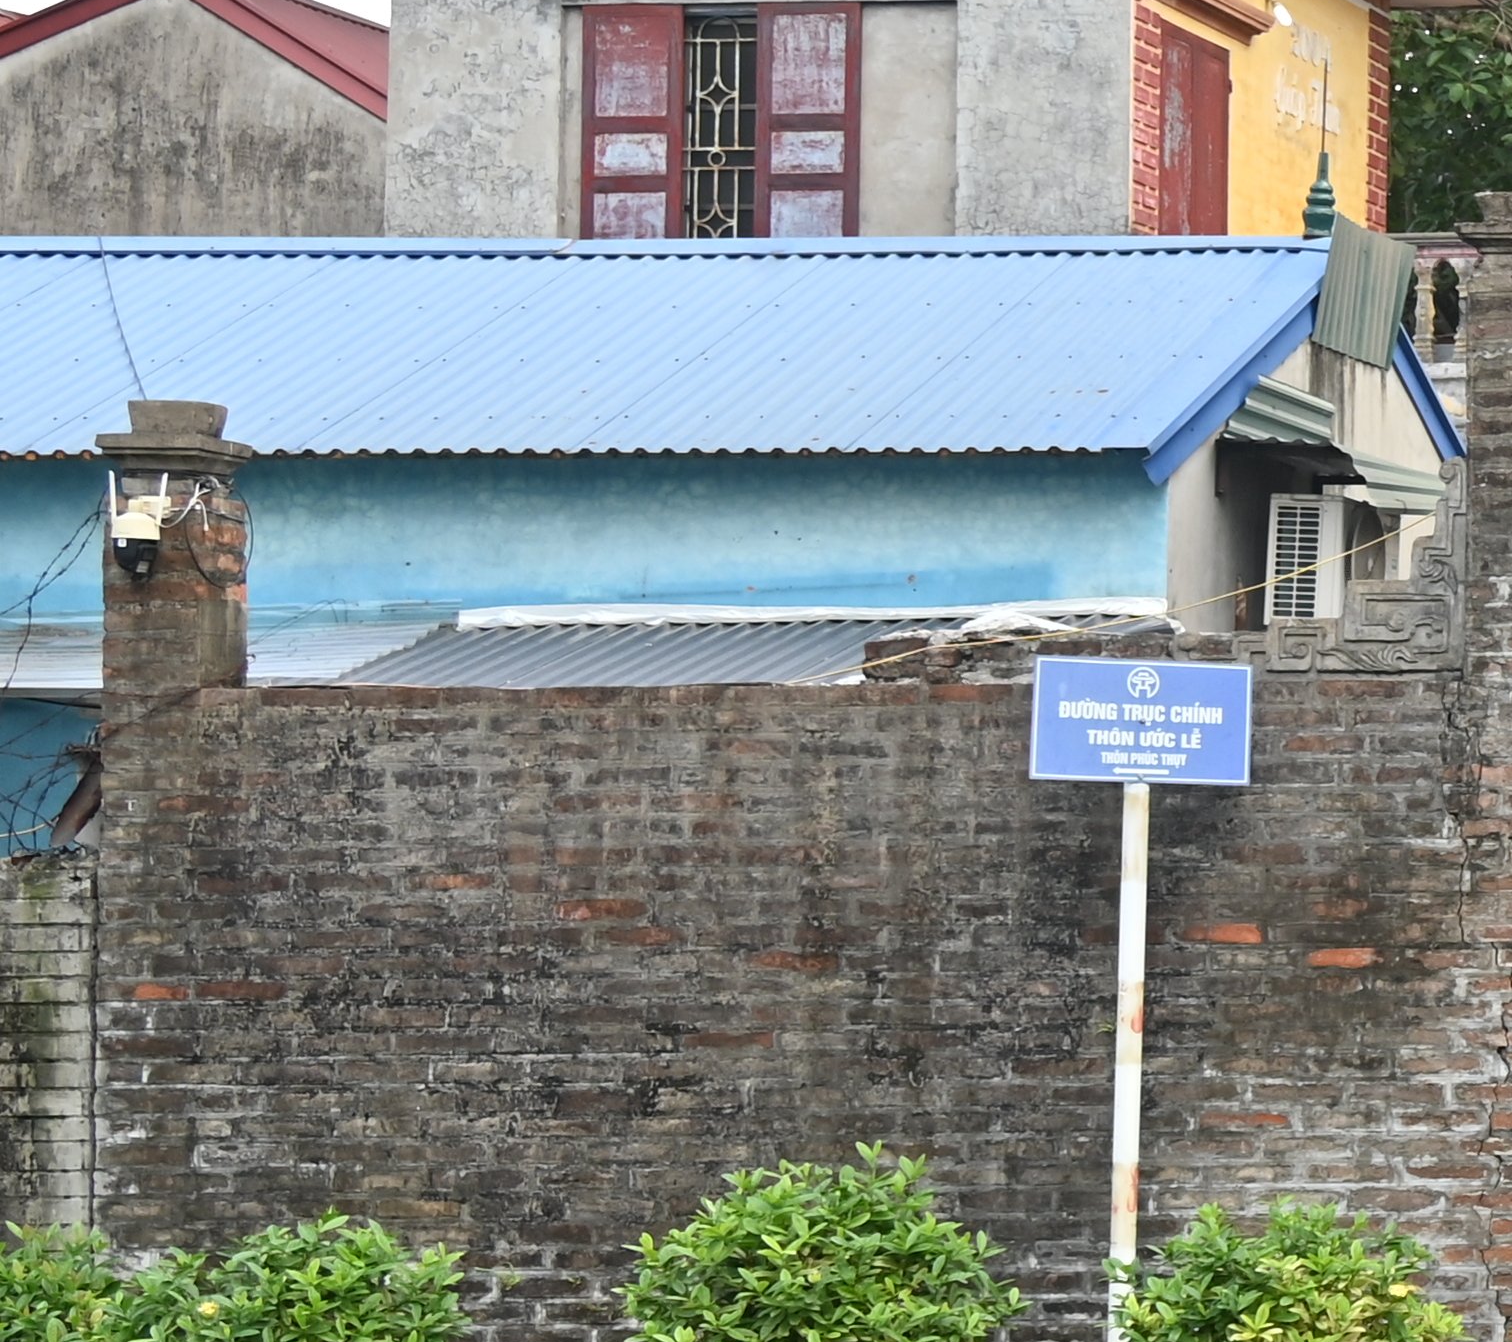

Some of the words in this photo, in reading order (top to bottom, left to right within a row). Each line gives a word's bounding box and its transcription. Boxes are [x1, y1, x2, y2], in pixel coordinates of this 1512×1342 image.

[1058, 698, 1118, 721] ĐƯỜNG
[1122, 704, 1166, 726] TRỤC
[1170, 702, 1224, 725] CHÍNH
[1087, 728, 1135, 746] THÔN
[1139, 727, 1177, 748] ƯỚC
[1181, 729, 1202, 749] LỄ
[1101, 751, 1129, 765] THÔN
[1130, 750, 1159, 766] PHÚC
